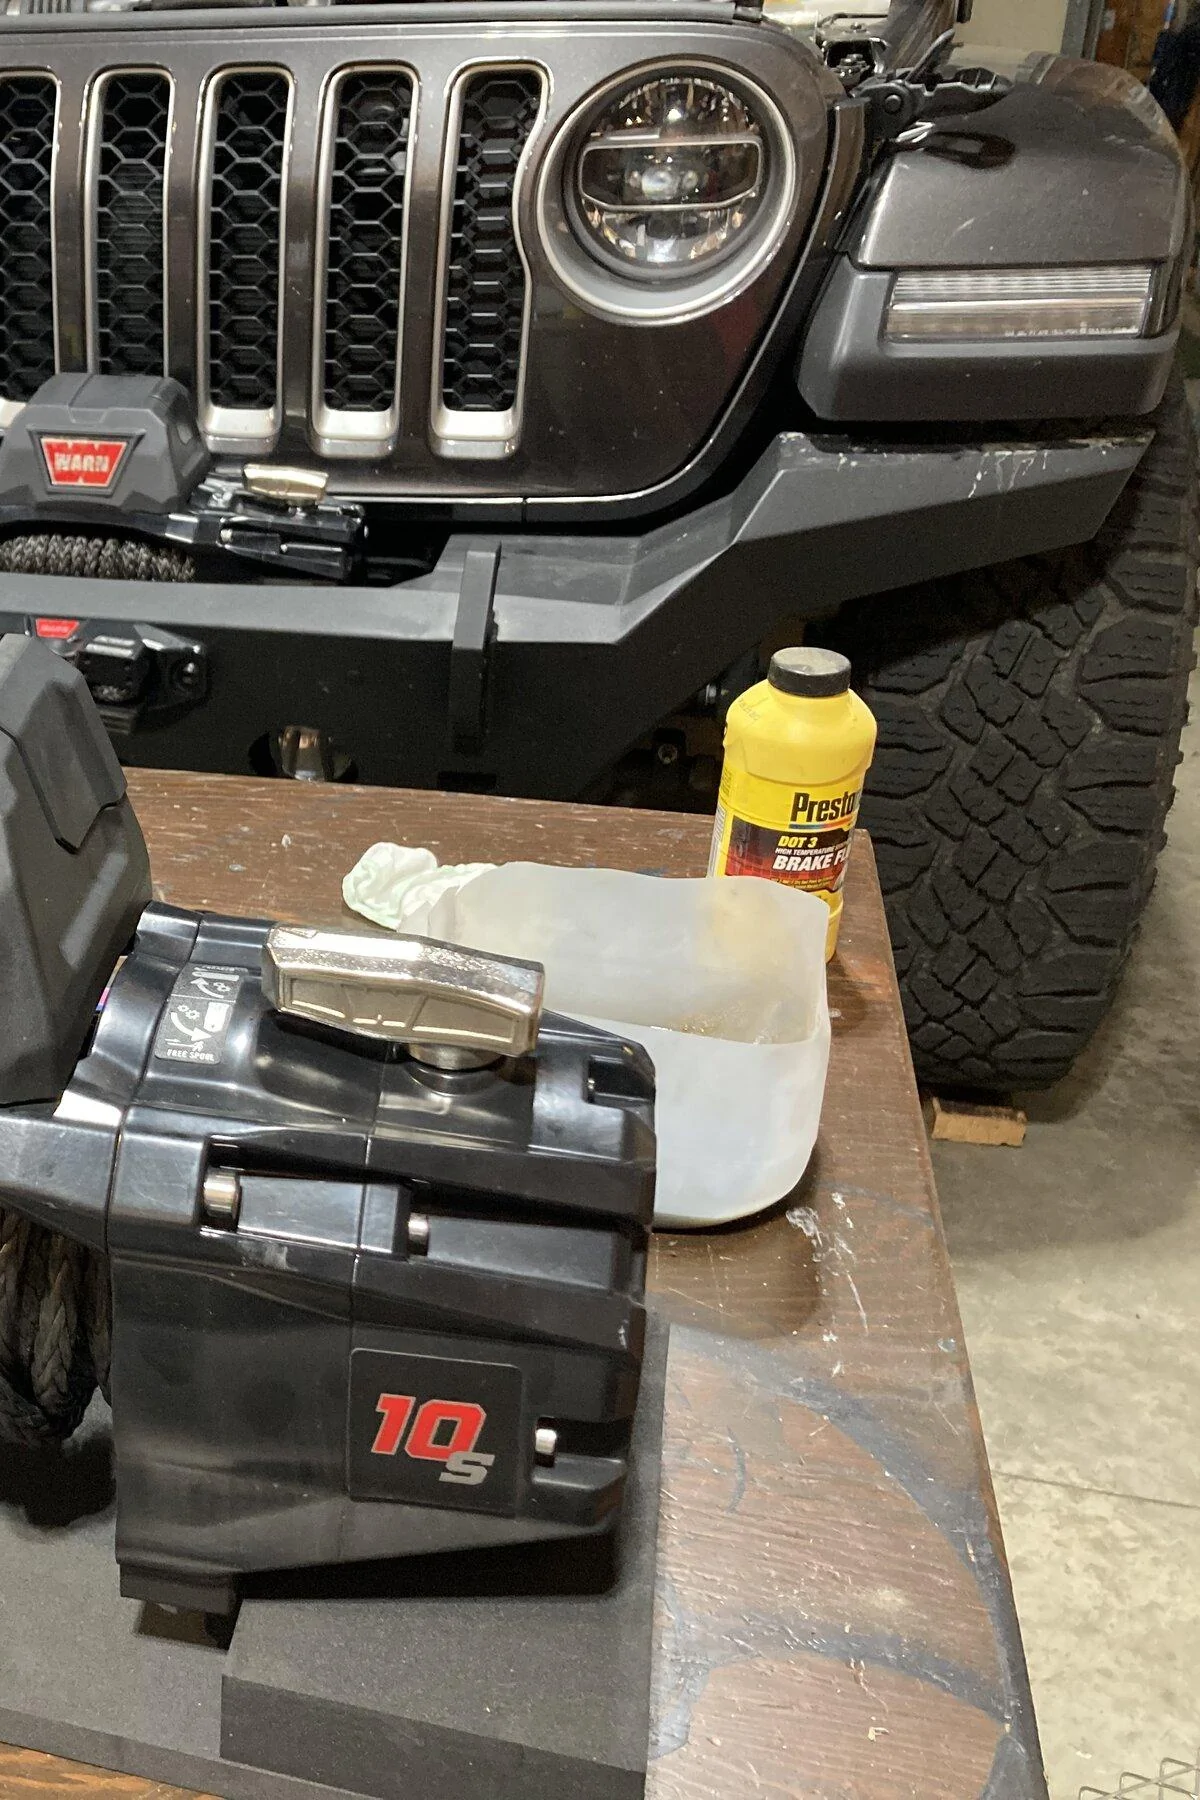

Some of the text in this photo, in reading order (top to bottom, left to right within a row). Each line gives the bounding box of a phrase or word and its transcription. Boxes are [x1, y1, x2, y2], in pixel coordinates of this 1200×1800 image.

[54, 452, 110, 472] WARN
[778, 836, 818, 848] DOT 3
[775, 847, 793, 855] HIGH
[793, 845, 836, 856] TEMPERATURE
[772, 853, 834, 872] BRAKE
[167, 1048, 215, 1062] FREE SPOOL
[371, 1393, 496, 1486] 10 S
